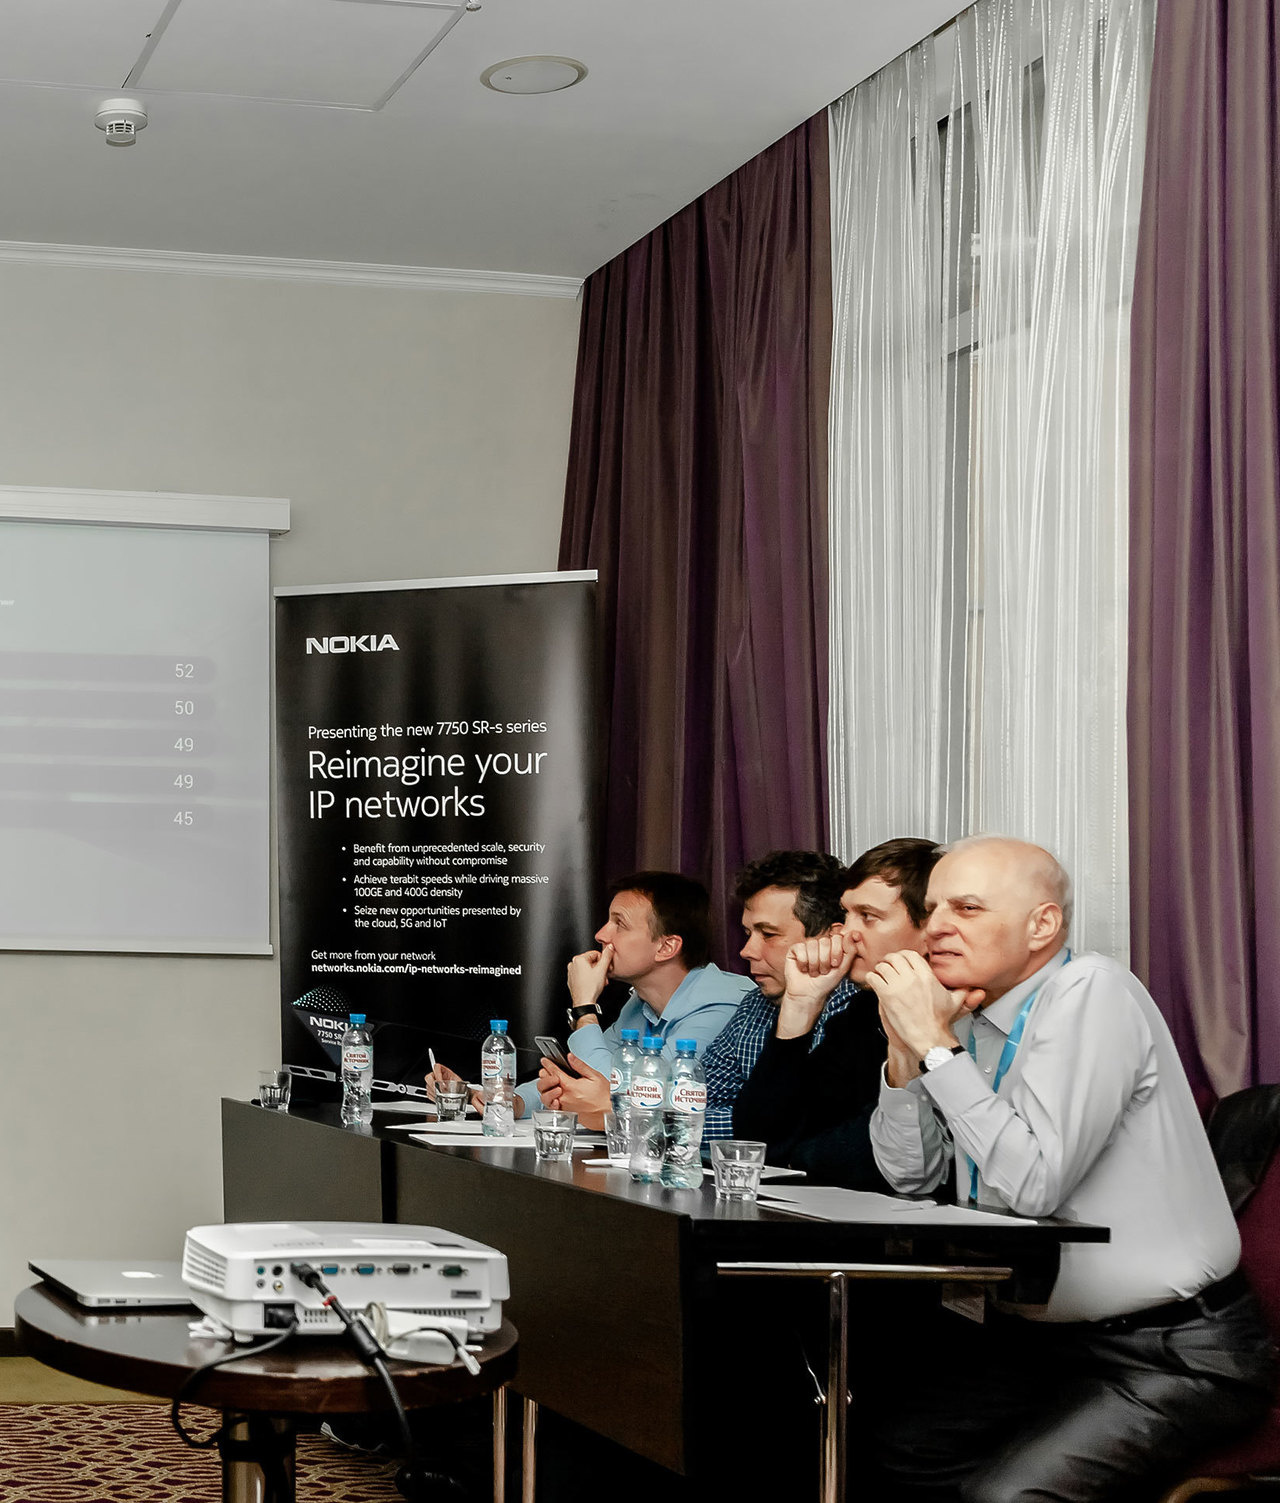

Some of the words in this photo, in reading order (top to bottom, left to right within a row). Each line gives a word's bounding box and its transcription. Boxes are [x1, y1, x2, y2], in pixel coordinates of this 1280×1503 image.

[306, 634, 400, 655] NOKIA
[175, 663, 194, 678] 52
[175, 700, 194, 715] 50
[308, 725, 377, 741] Presenting
[380, 723, 403, 737] the
[406, 725, 434, 737] new
[436, 721, 469, 735] 7750
[472, 720, 503, 734] SR-s
[506, 719, 547, 733] series
[174, 737, 194, 752] 49
[308, 747, 465, 786] Reimagine
[474, 751, 548, 784] your
[173, 774, 194, 789] 49
[310, 790, 335, 818] IP
[346, 786, 486, 818] networks
[173, 811, 194, 826] 45
[353, 843, 386, 853] Benefit
[388, 842, 410, 853] from
[412, 842, 480, 854] unprecedented
[481, 842, 506, 853] scale,
[508, 842, 546, 853] security
[353, 856, 370, 866] and
[372, 856, 414, 868] capability
[416, 855, 450, 866] without
[452, 855, 508, 867] compromise
[353, 874, 388, 884] Achieve
[390, 874, 419, 884] terabit
[421, 874, 453, 886] speeds
[454, 874, 477, 884] while
[479, 874, 509, 887] driving
[511, 874, 549, 884] massive
[353, 887, 383, 897] 100GE
[384, 887, 402, 897] and
[404, 887, 428, 897] 400G
[430, 887, 463, 899] density
[354, 905, 377, 915] Seize
[379, 907, 399, 915] new
[400, 905, 460, 917] opportunities
[462, 905, 508, 917] presented
[509, 905, 522, 918] by
[354, 918, 370, 928] the
[371, 918, 399, 930] cloud,
[400, 918, 413, 928] 5G
[414, 918, 431, 928] and
[433, 918, 448, 928] IoT
[311, 950, 327, 960] Get
[329, 952, 352, 960] more
[354, 950, 376, 960] from
[377, 952, 398, 962] your
[400, 951, 436, 961] network
[311, 963, 521, 977] networks.nokia.com/ip-networks-reimagined
[309, 1016, 349, 1032] NOKI
[317, 1029, 333, 1039] 7750
